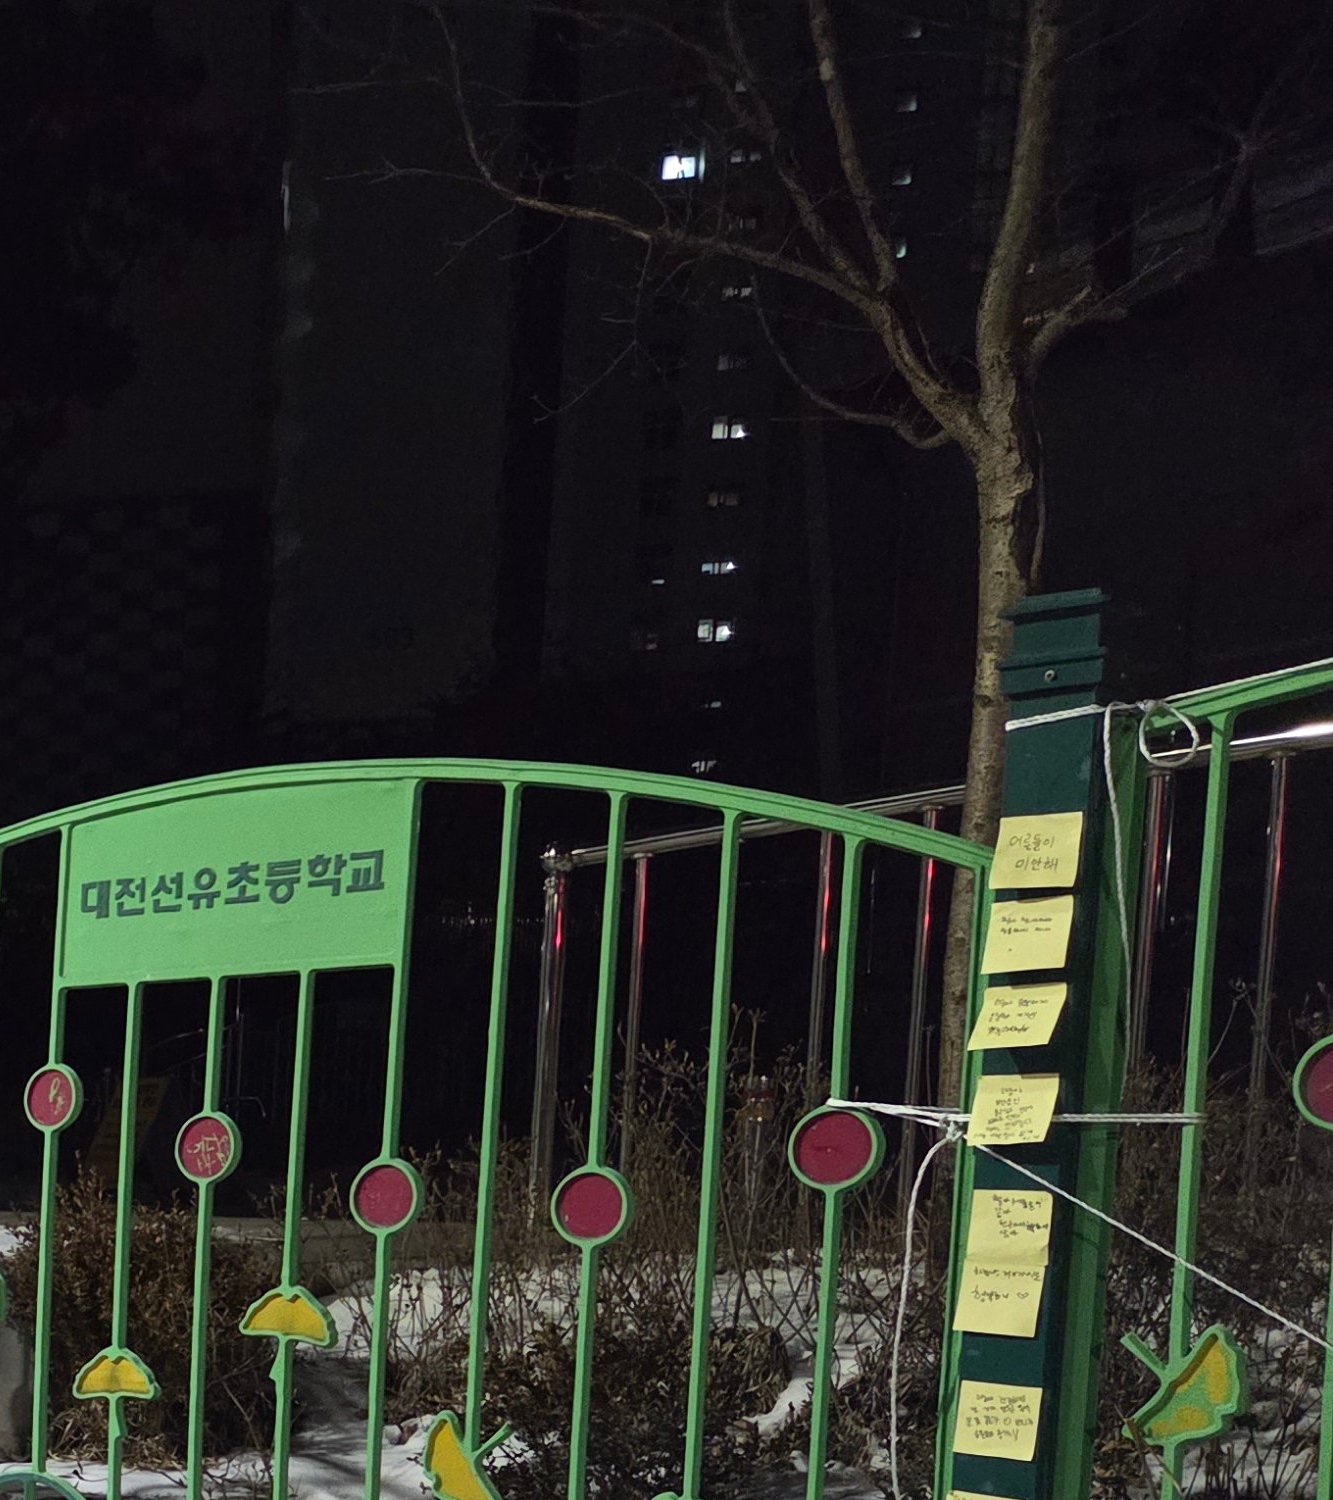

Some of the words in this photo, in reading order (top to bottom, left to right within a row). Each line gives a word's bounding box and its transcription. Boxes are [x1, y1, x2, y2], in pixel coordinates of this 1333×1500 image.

[1009, 833, 1055, 850] 어른들이
[1015, 857, 1059, 872] 미안해
[80, 849, 385, 919] 대전선유초등학교
